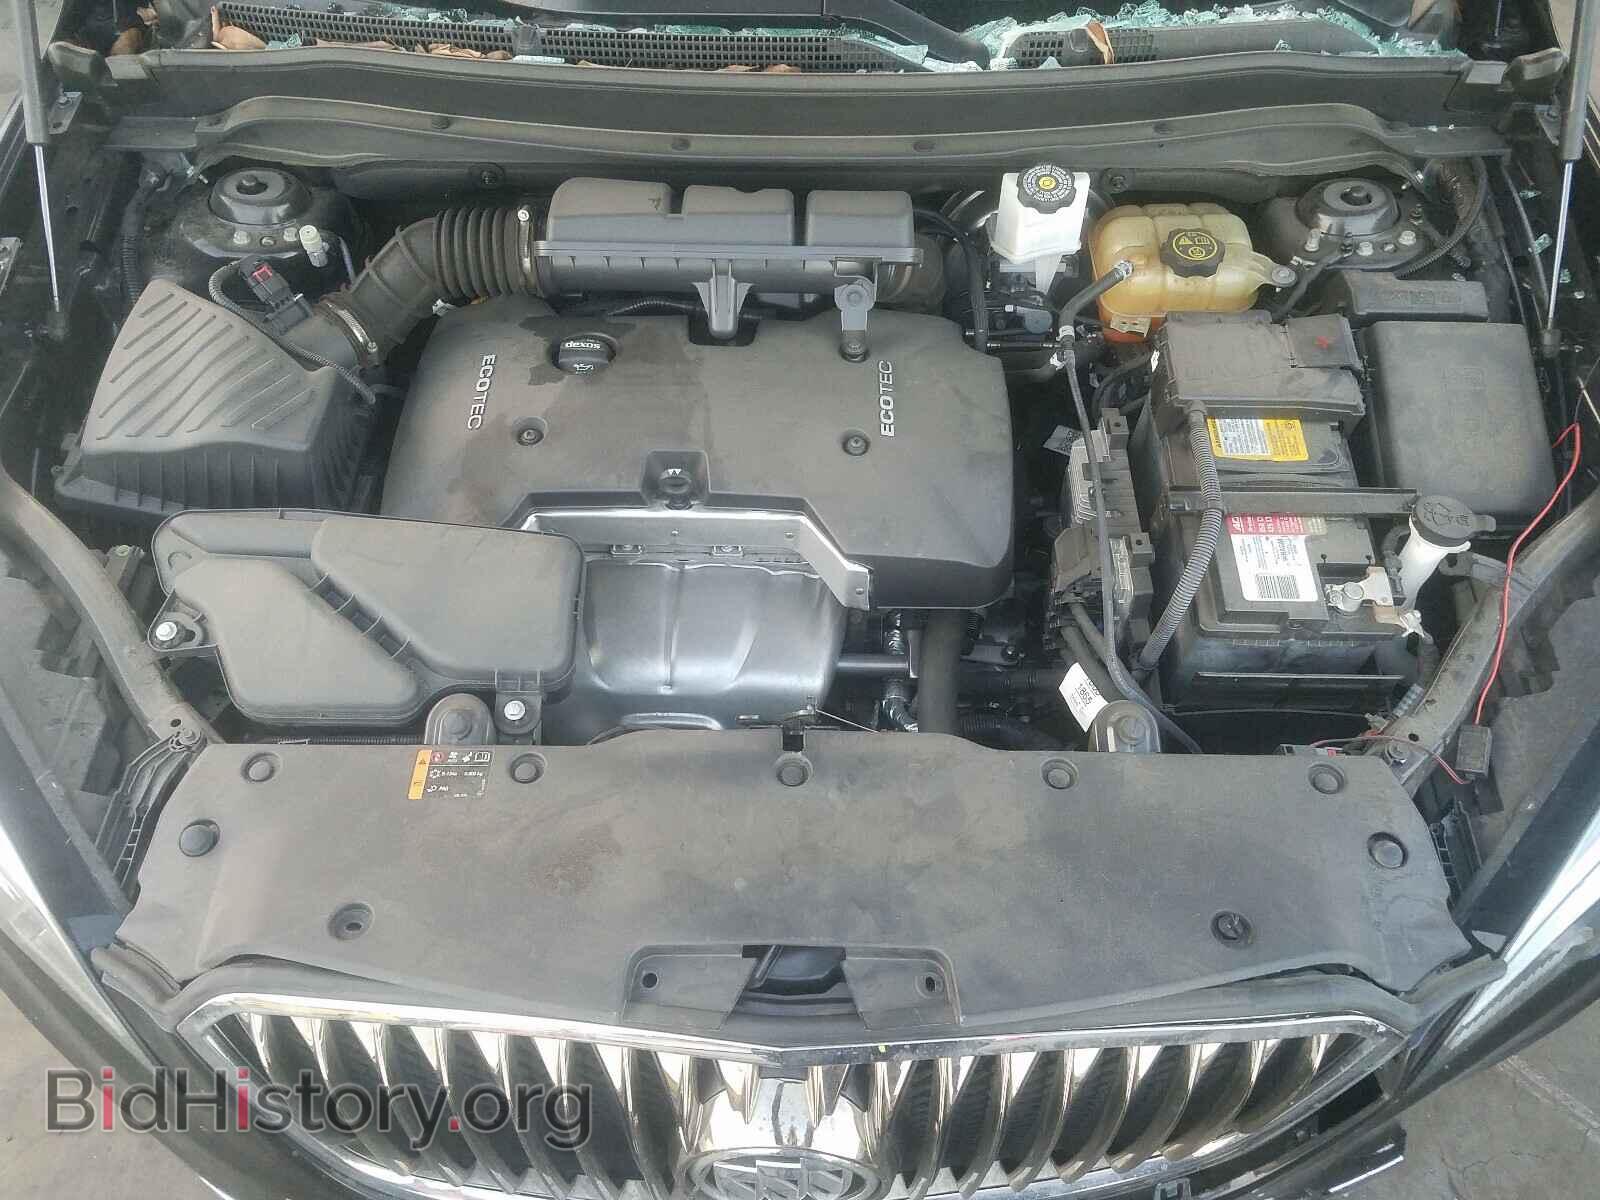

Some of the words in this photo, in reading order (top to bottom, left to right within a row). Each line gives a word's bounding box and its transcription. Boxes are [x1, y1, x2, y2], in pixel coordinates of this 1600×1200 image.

[565, 340, 601, 349] dexos
[467, 354, 496, 429] ECOTEC
[879, 360, 895, 436] ECOTEC
